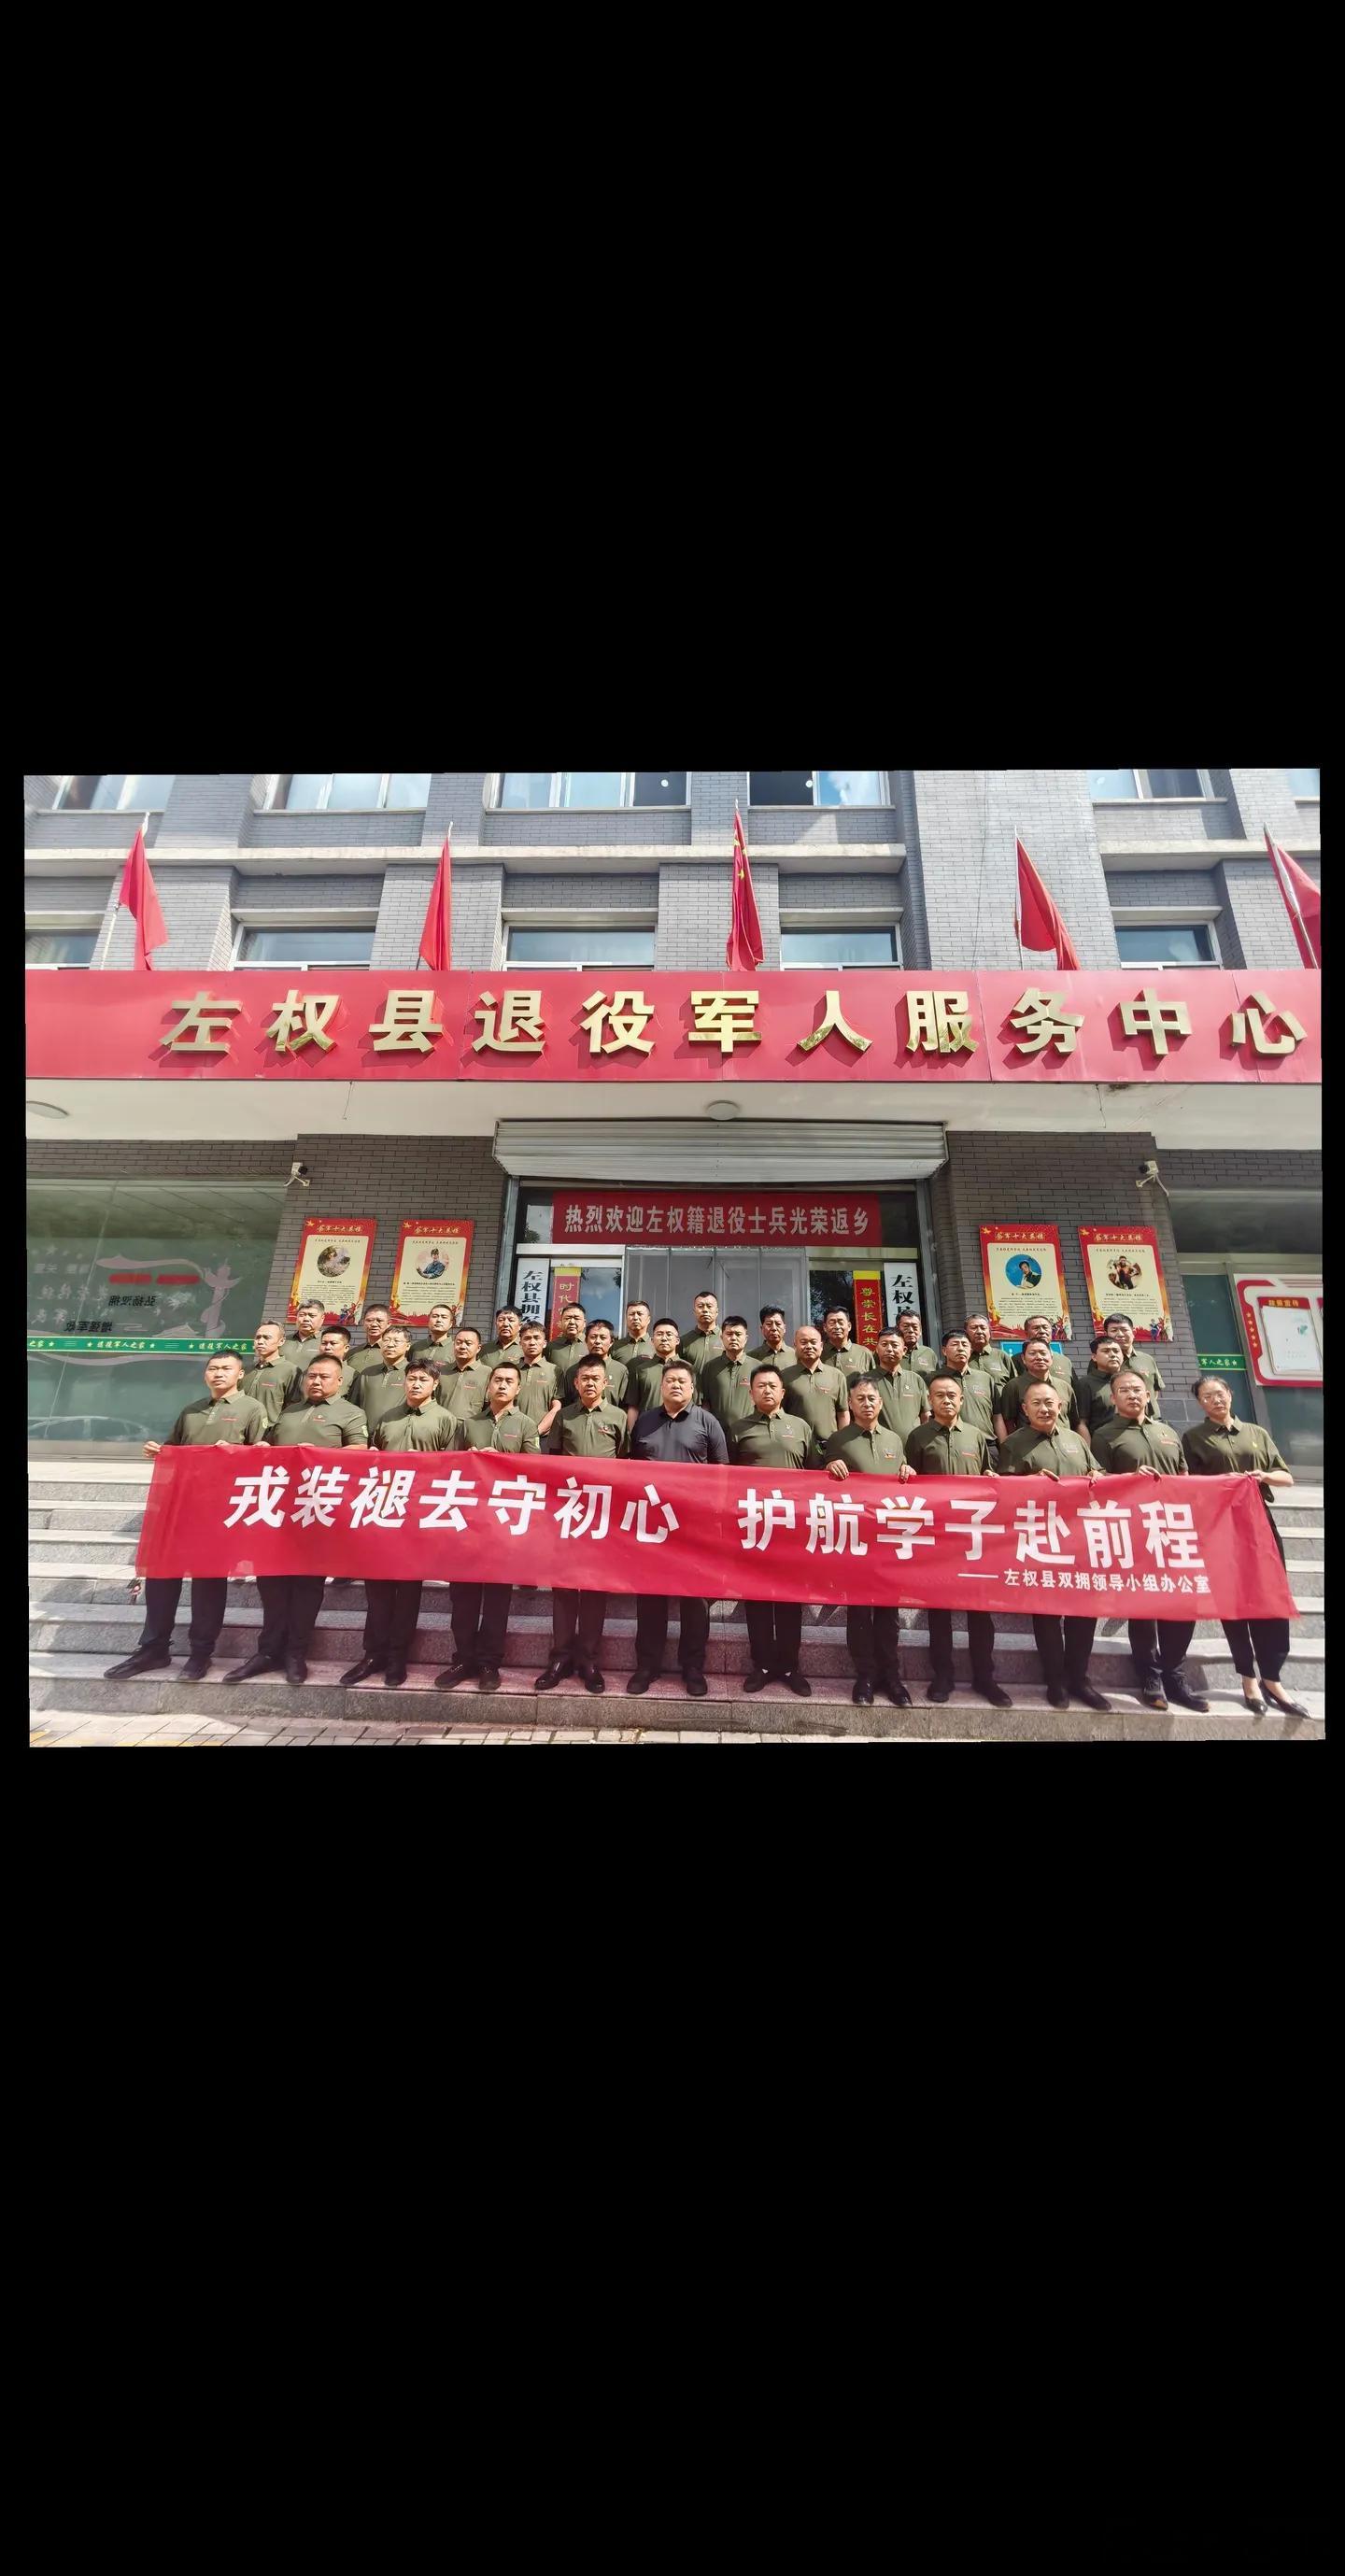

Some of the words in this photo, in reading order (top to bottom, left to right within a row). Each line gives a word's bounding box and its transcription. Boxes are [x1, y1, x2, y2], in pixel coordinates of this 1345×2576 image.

[160, 987, 1308, 1057] 左权县退役军人服务中心
[564, 1204, 870, 1236] 热烈欢迎左权籍退役士兵光荣返乡
[1199, 1357, 1231, 1367] 军人之家
[223, 1465, 680, 1544] 戎装褪去守初心
[737, 1488, 1206, 1570] 护航学子赴前程
